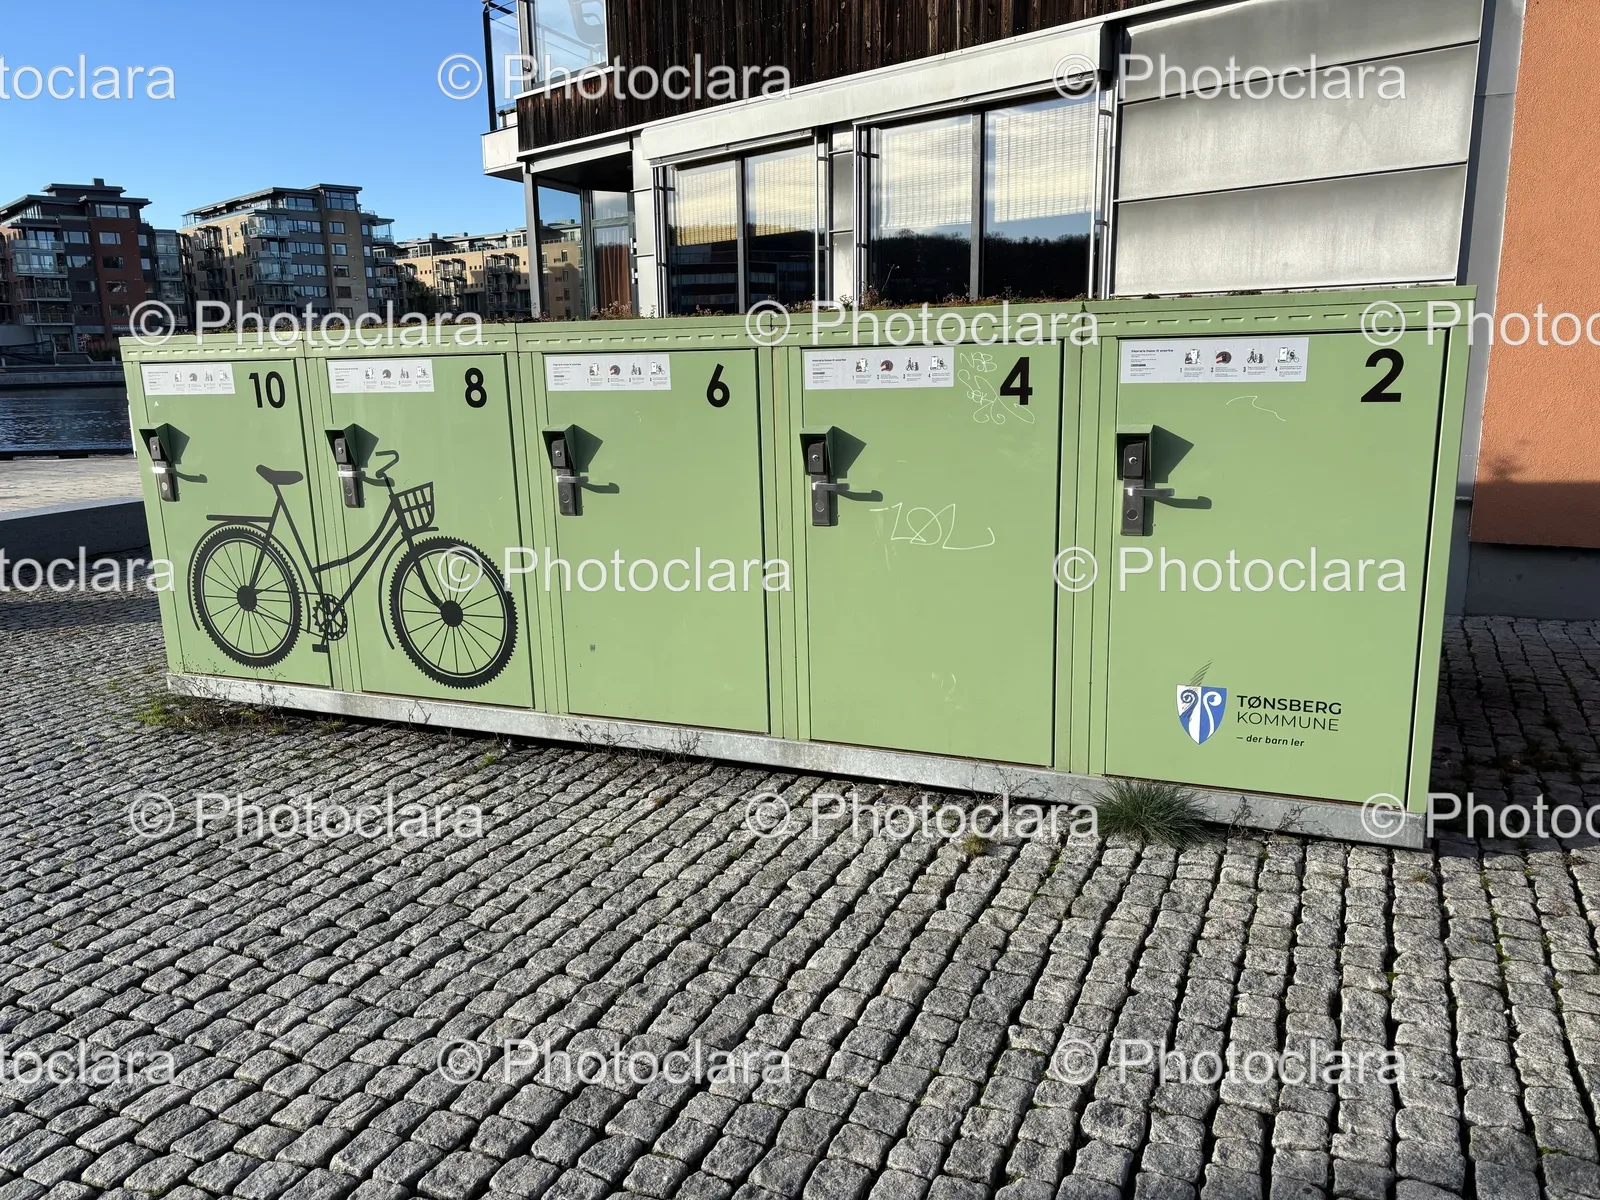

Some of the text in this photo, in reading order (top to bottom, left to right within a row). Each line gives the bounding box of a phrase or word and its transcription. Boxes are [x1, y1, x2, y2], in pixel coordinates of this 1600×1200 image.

[248, 371, 286, 409] 10
[464, 367, 487, 408] 8
[706, 363, 730, 408] 6
[999, 356, 1033, 406] 4
[1360, 347, 1405, 403] 2
[1236, 695, 1342, 715] TØNSBERG
[1237, 711, 1340, 731] KOMMUNE
[1246, 735, 1263, 744] der
[1265, 736, 1289, 746] barn
[1290, 738, 1305, 747] ler
